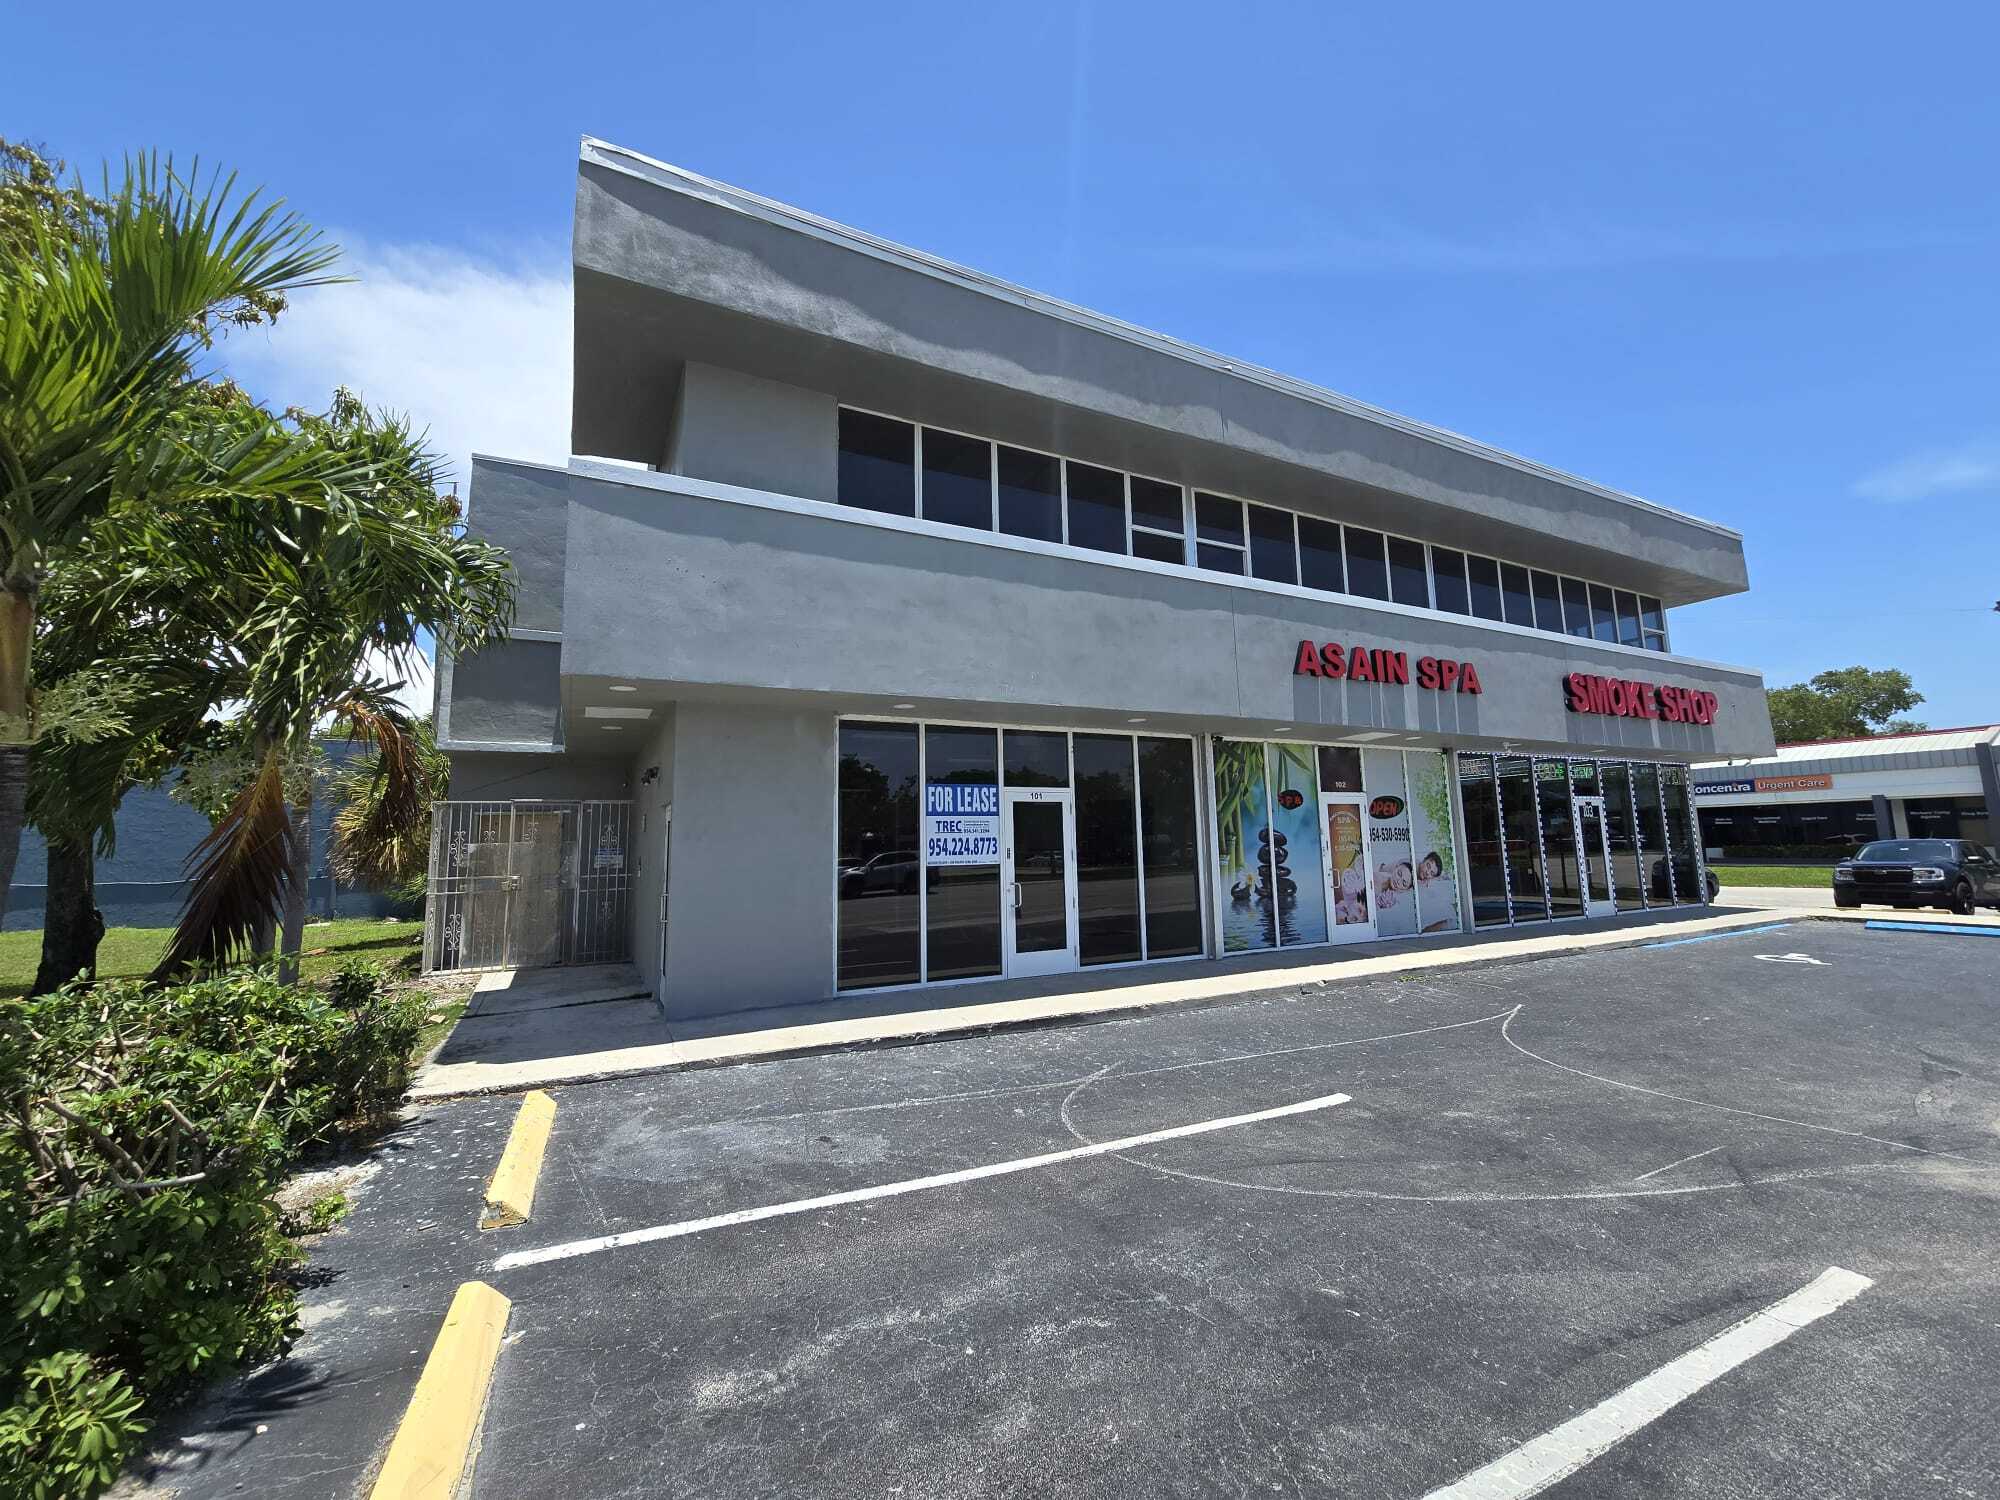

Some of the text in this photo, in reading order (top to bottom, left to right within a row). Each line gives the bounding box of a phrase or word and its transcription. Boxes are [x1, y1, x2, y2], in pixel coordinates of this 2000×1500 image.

[1293, 640, 1482, 694] ASAIN SPA
[1562, 672, 1719, 725] SMOKE SHOP
[1335, 781, 1346, 789] 102
[1693, 778, 1825, 794] oncentra Urgent Care
[928, 786, 997, 813] FOR LEASE
[1030, 792, 1043, 800] 101
[1583, 805, 1594, 818] 103
[936, 820, 962, 832] TREC
[928, 836, 998, 857] 954.224.8773
